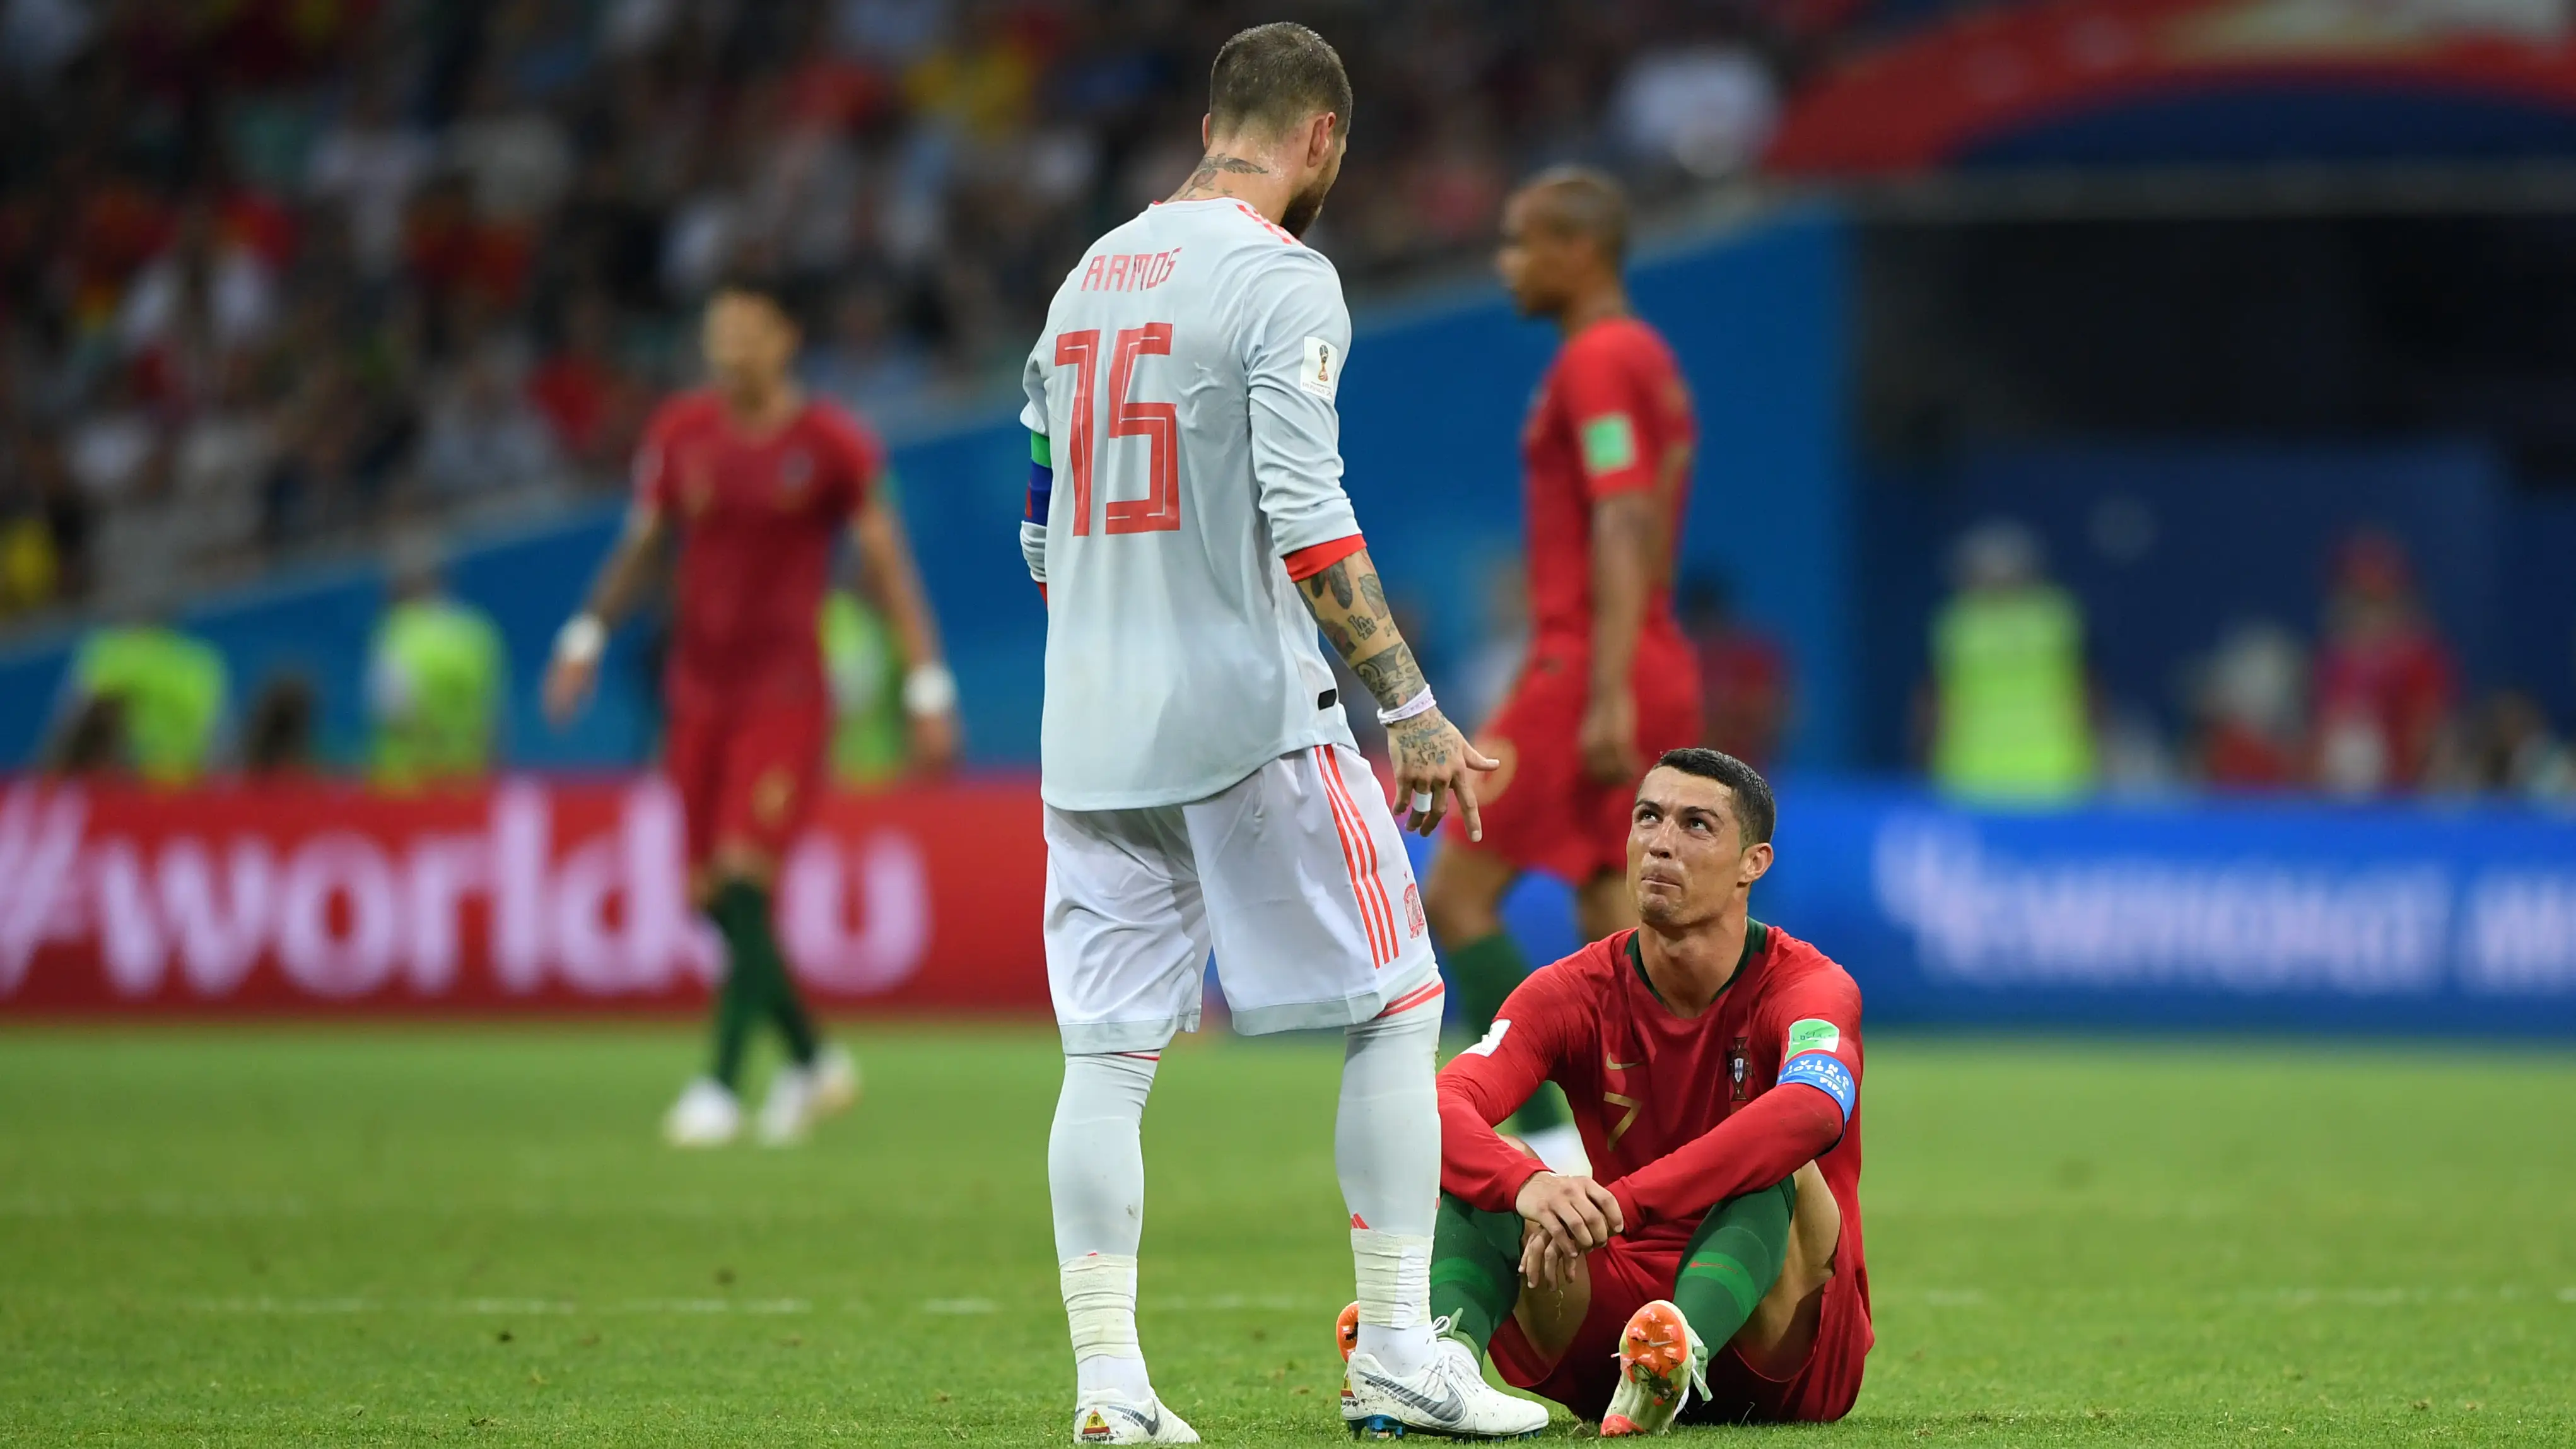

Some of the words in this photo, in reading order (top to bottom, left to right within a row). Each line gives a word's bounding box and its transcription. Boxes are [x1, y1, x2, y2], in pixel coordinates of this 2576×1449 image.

[1080, 247, 1183, 292] RAMOS
[1055, 322, 1180, 536] 15
[1603, 1091, 1642, 1152] 7
